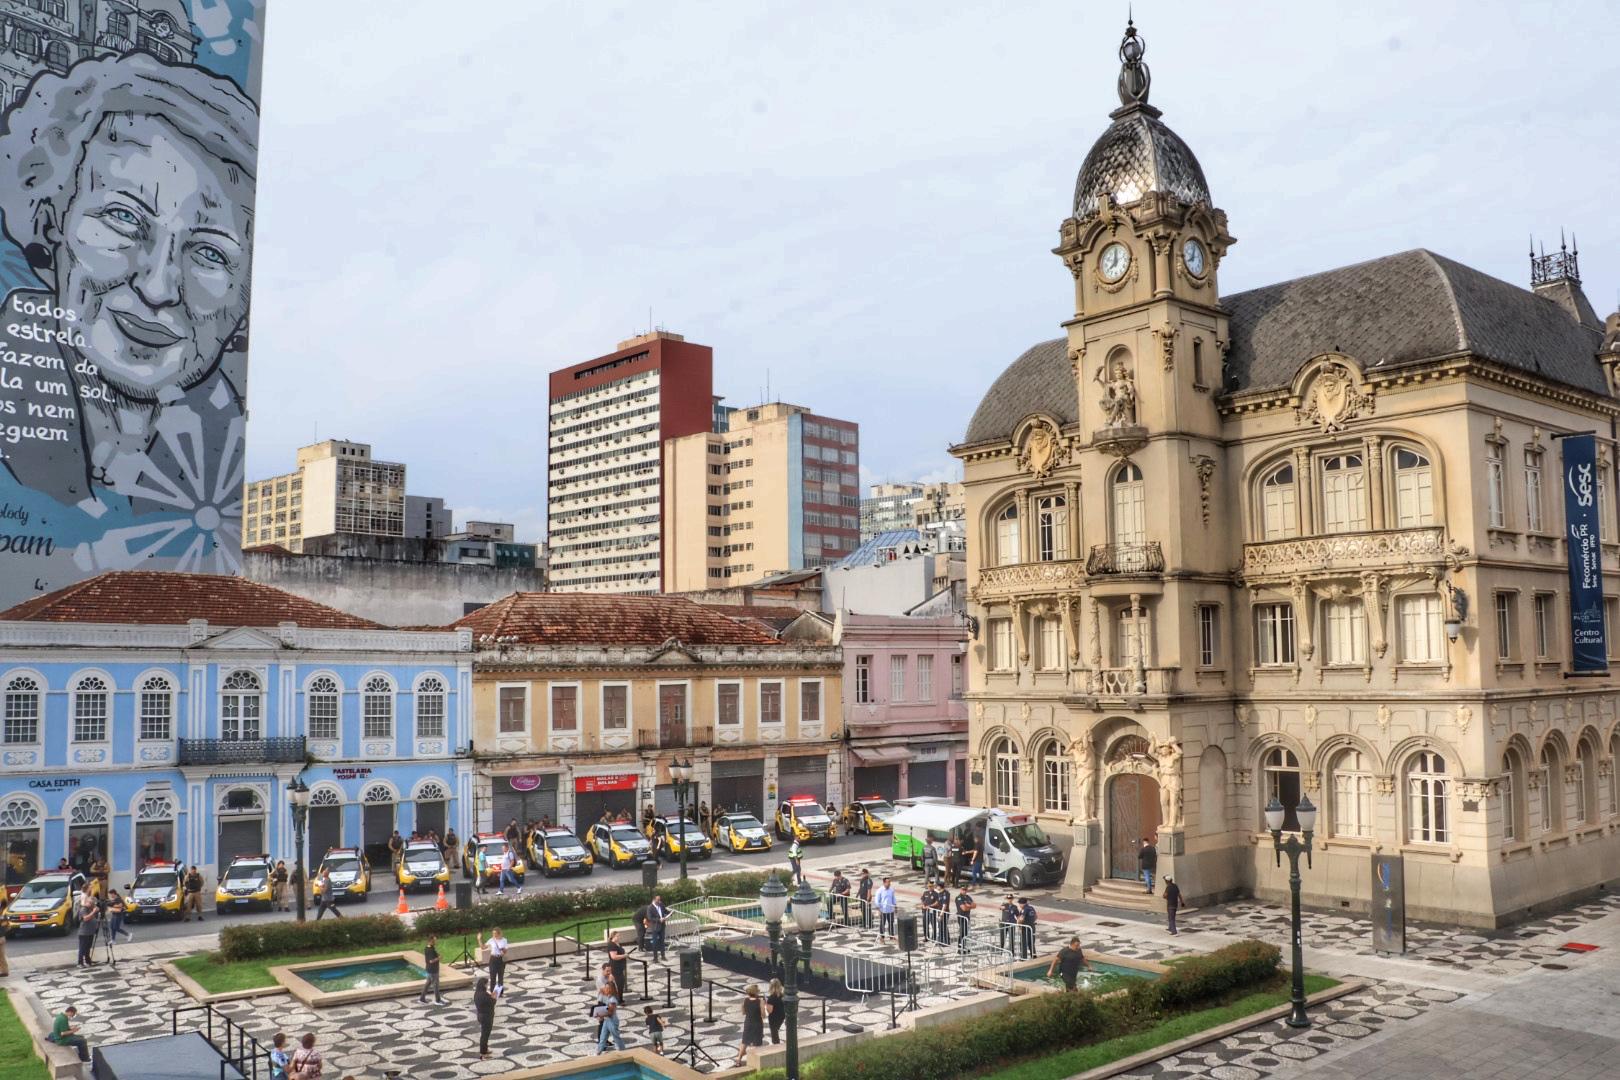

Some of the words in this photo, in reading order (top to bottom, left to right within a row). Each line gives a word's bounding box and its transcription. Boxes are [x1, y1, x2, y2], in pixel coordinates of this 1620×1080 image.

[13, 294, 76, 322] todos
[75, 358, 98, 375] da
[35, 380, 68, 396] um
[80, 383, 116, 403] sol.
[28, 402, 75, 420] nem
[1580, 523, 1589, 536] PR
[1581, 538, 1591, 589] Fecomércio
[1574, 629, 1600, 637] Centro
[1574, 636, 1603, 644] Cultural
[54, 779, 80, 787] EDITH
